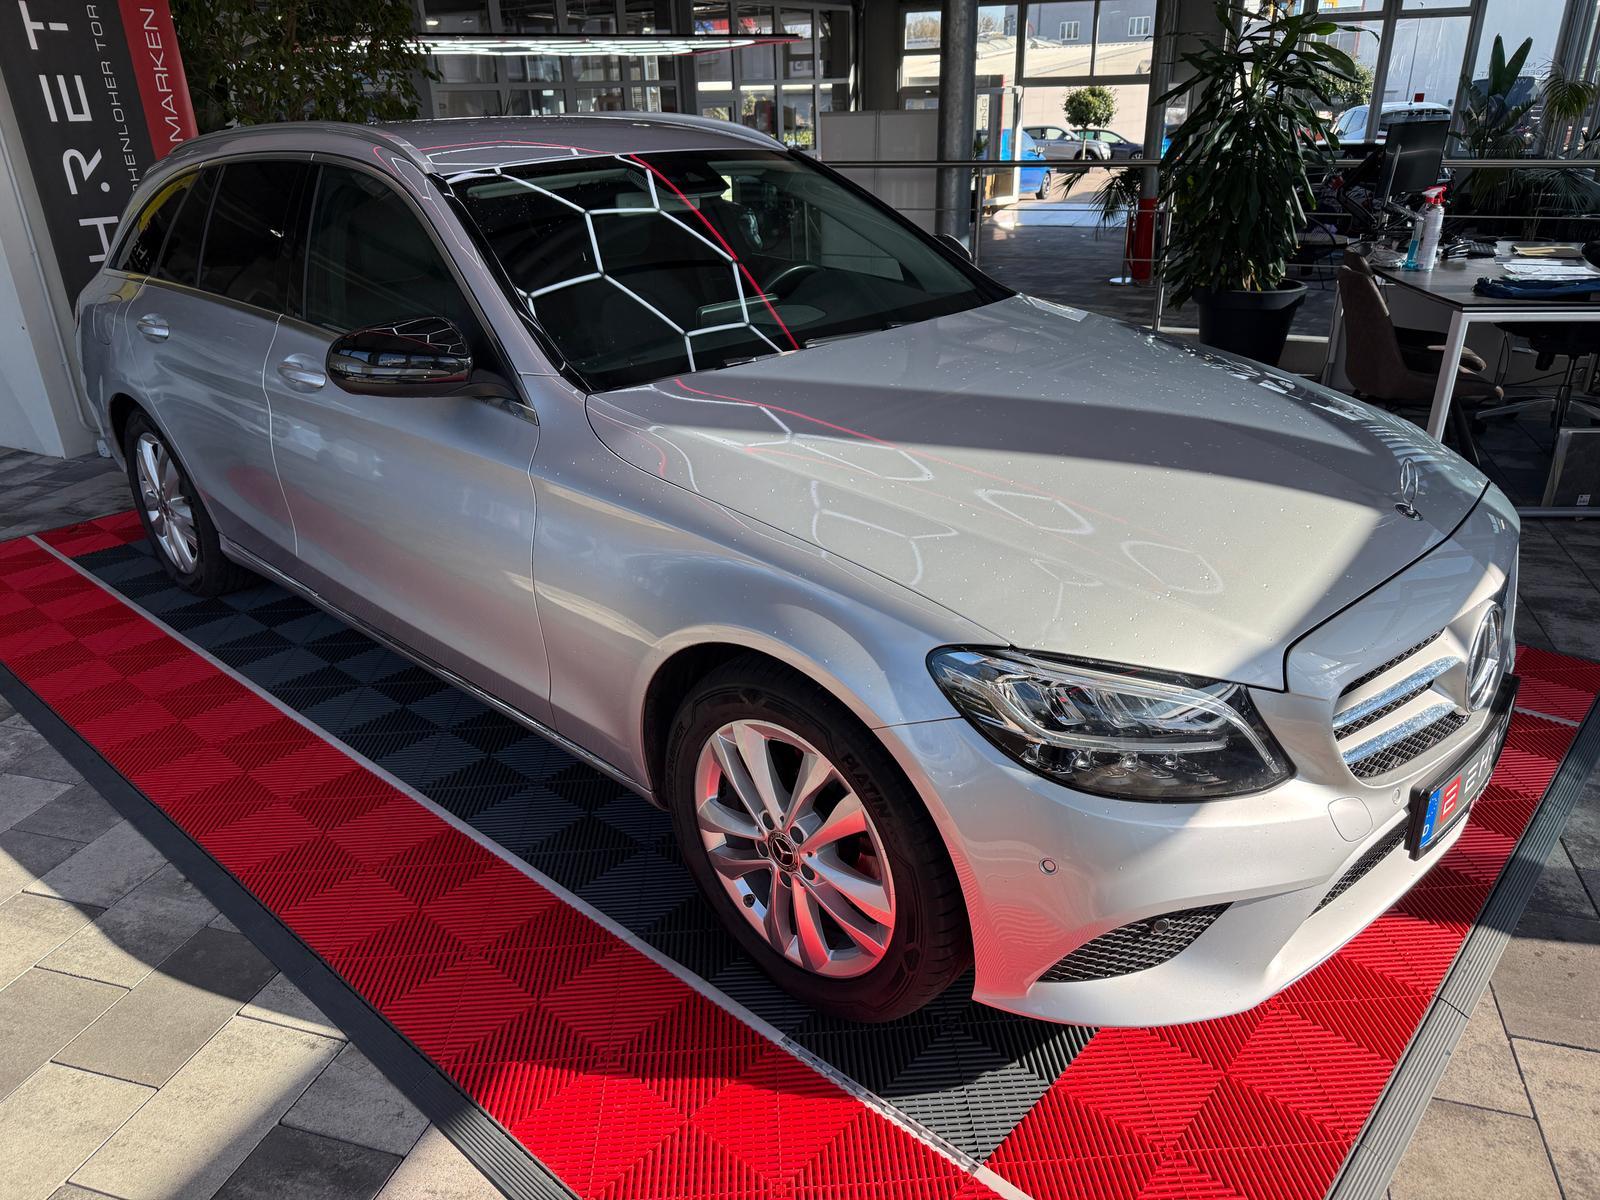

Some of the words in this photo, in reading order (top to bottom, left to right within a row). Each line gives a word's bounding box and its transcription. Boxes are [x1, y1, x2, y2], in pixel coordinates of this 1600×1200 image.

[87, 4, 107, 51] TOR
[140, 8, 183, 141] MARKEN
[101, 61, 139, 191] HENLOHER
